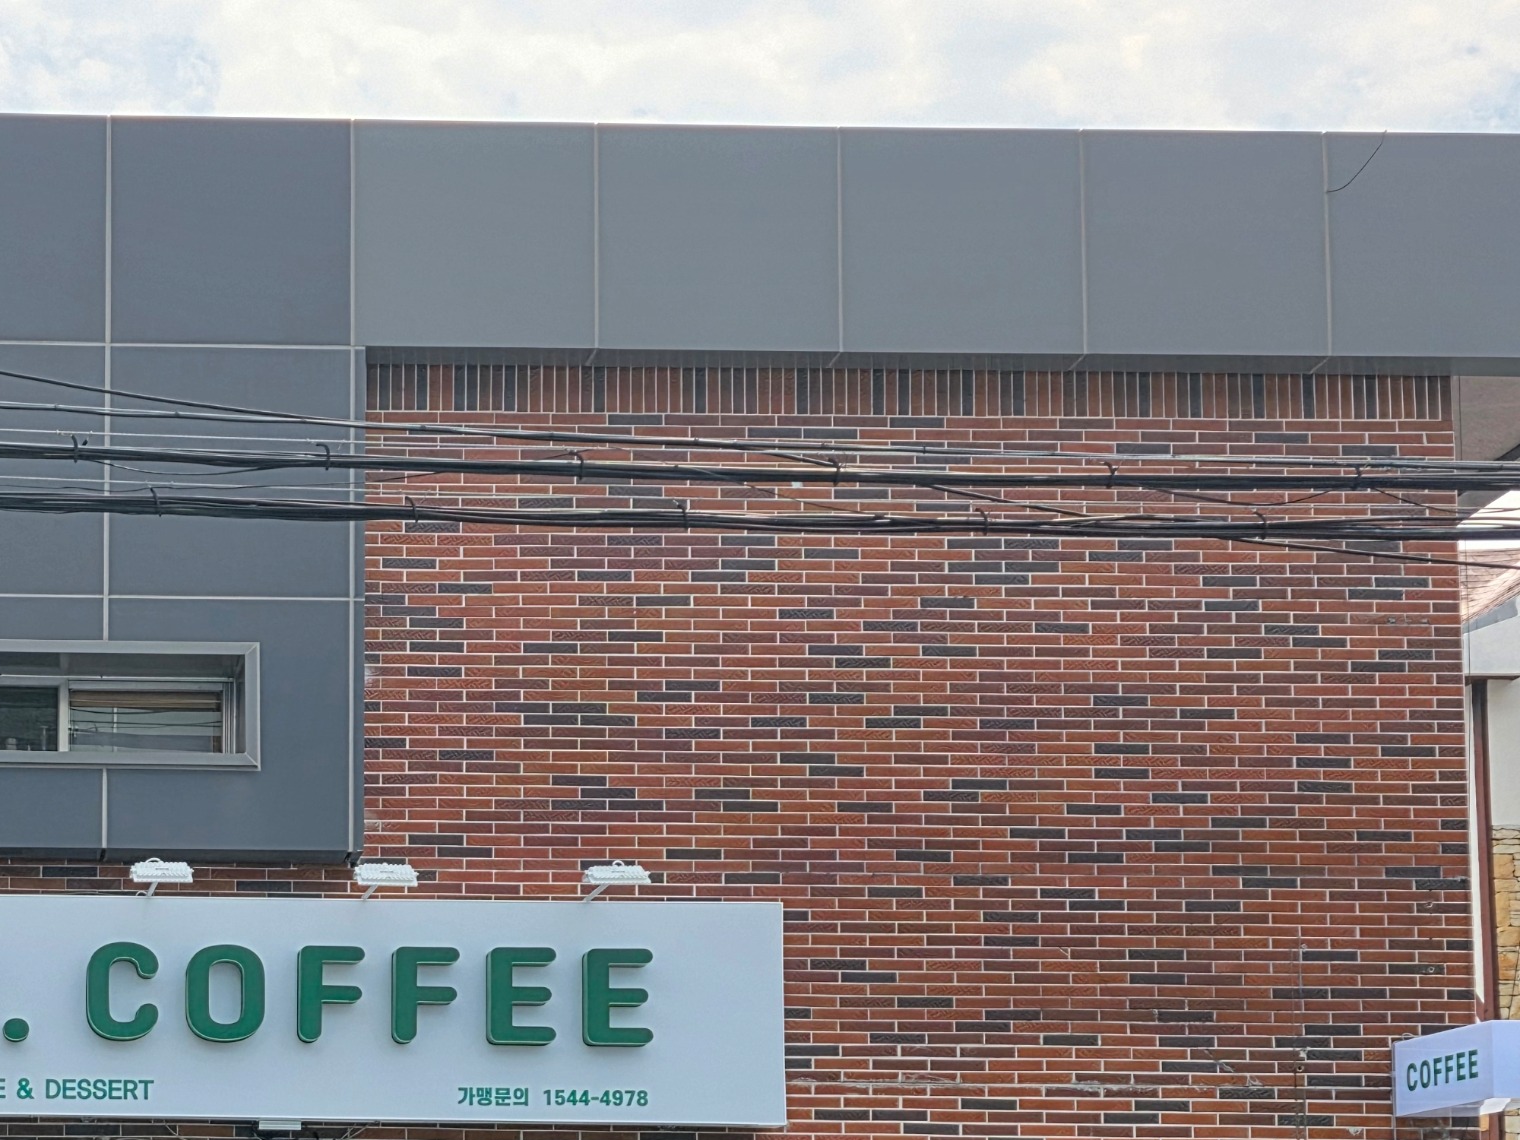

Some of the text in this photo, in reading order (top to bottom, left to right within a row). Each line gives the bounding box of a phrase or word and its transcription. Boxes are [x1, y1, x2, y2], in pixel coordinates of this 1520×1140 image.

[86, 941, 655, 1048] COFFEE
[1406, 1049, 1479, 1092] COFFEE
[16, 1077, 34, 1099] &
[45, 1078, 154, 1100] DESSERT
[457, 1087, 649, 1107] 가맹문의 1544-4978
